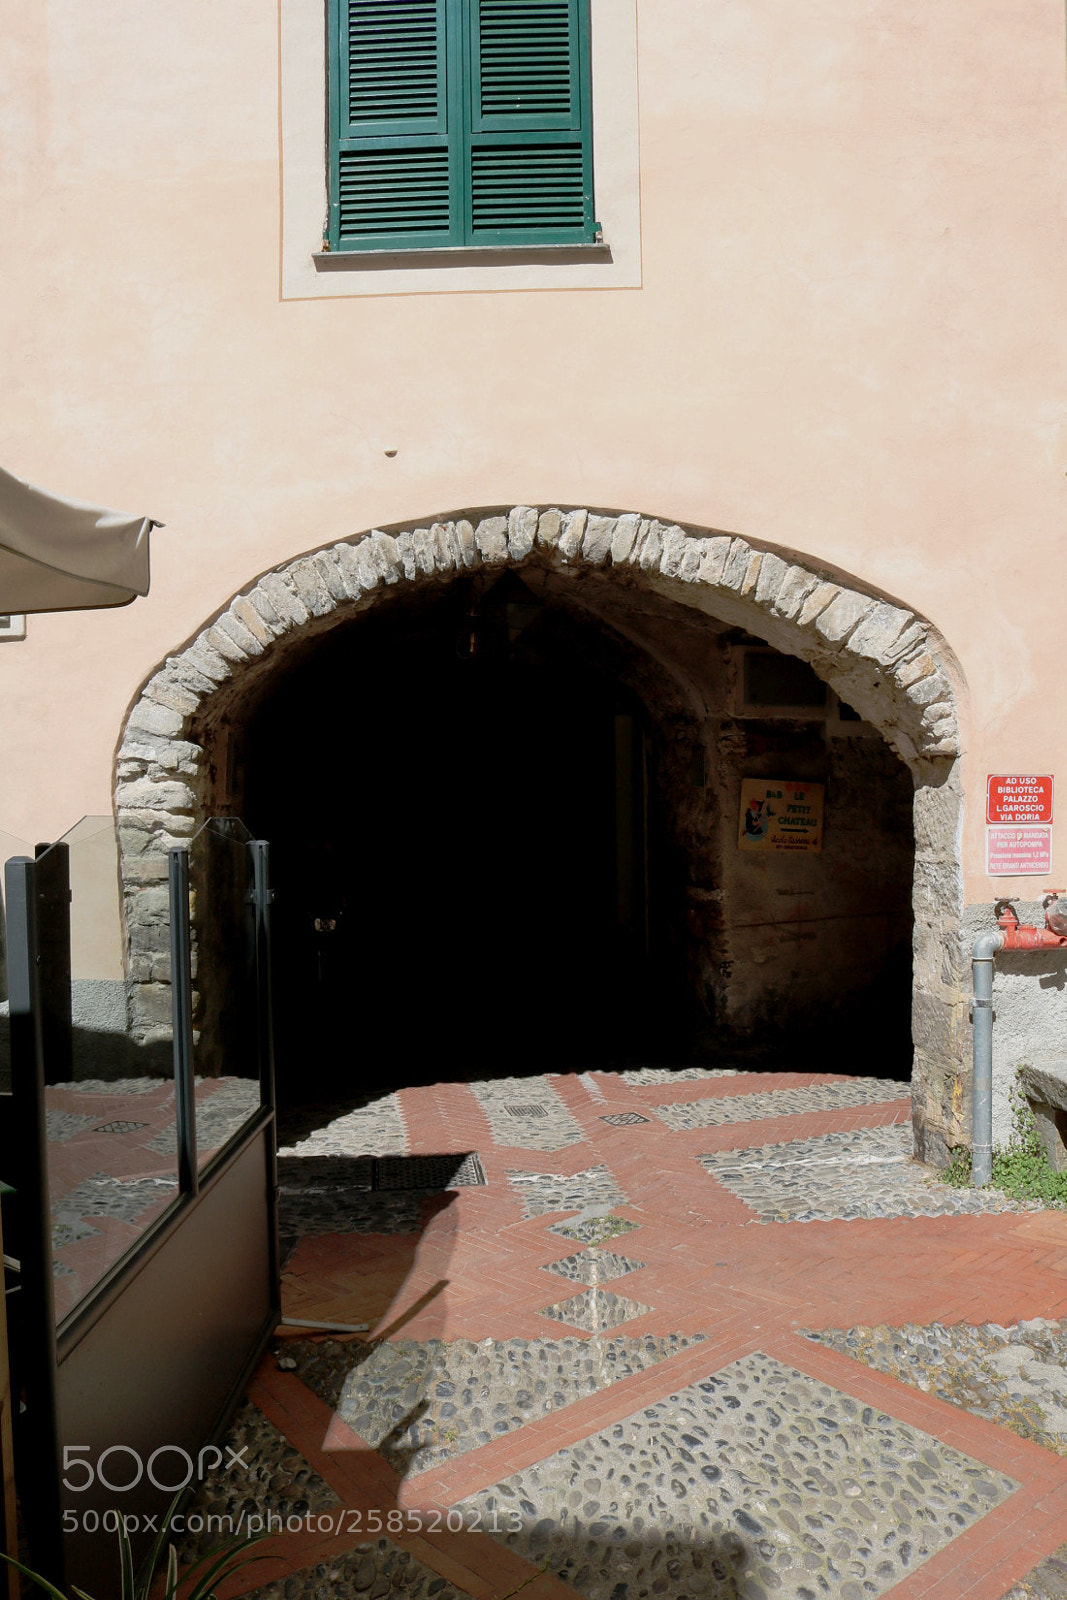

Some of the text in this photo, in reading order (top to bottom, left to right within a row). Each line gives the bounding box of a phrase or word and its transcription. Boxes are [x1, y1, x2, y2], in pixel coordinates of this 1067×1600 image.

[1006, 777, 1037, 785] AD USO
[997, 786, 1044, 794] BIBLIOTECA
[1003, 795, 1038, 803] PALAZZO
[787, 804, 811, 814] PETIT
[1000, 813, 1040, 821] VIA DORIA
[777, 816, 818, 827] CHATEAU
